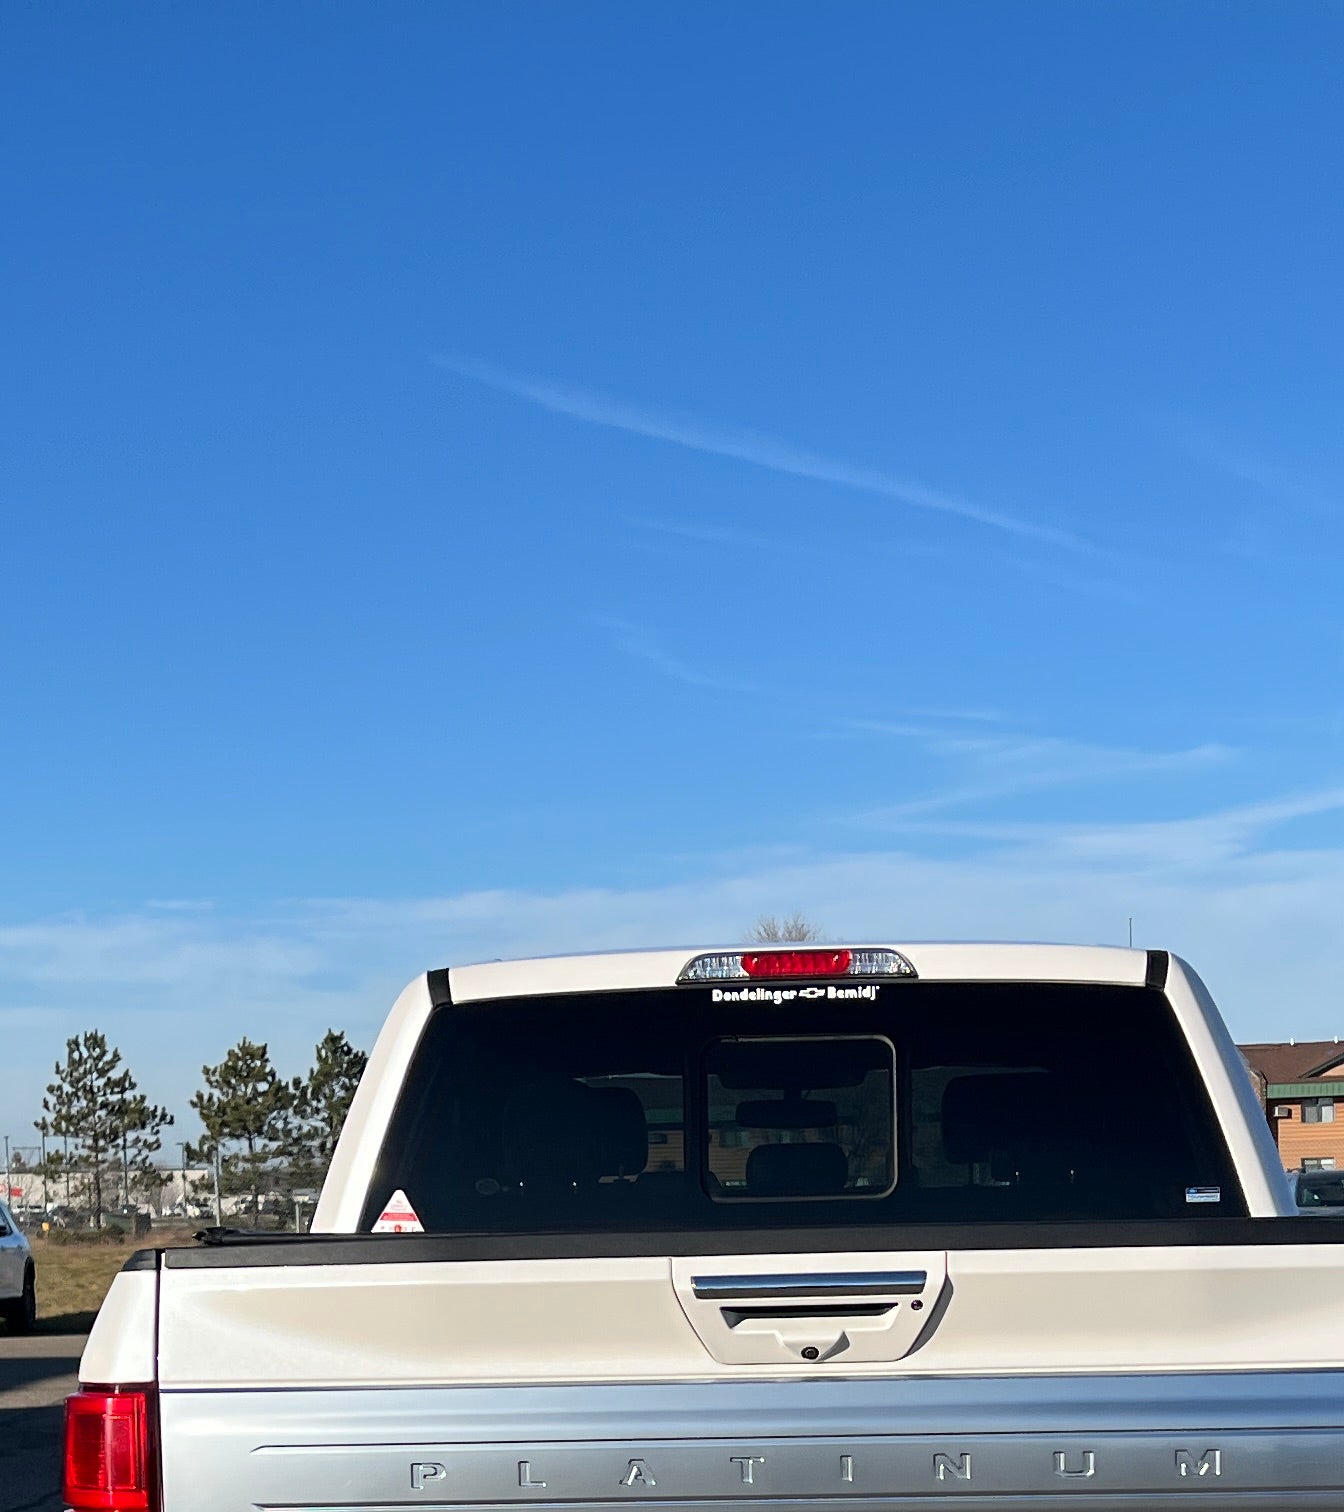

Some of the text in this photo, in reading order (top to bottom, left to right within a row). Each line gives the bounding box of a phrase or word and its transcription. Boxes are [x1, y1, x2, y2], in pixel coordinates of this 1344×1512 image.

[712, 986, 880, 1004] Dondelinger Bemidj
[410, 1448, 1222, 1490] PLATINUM
